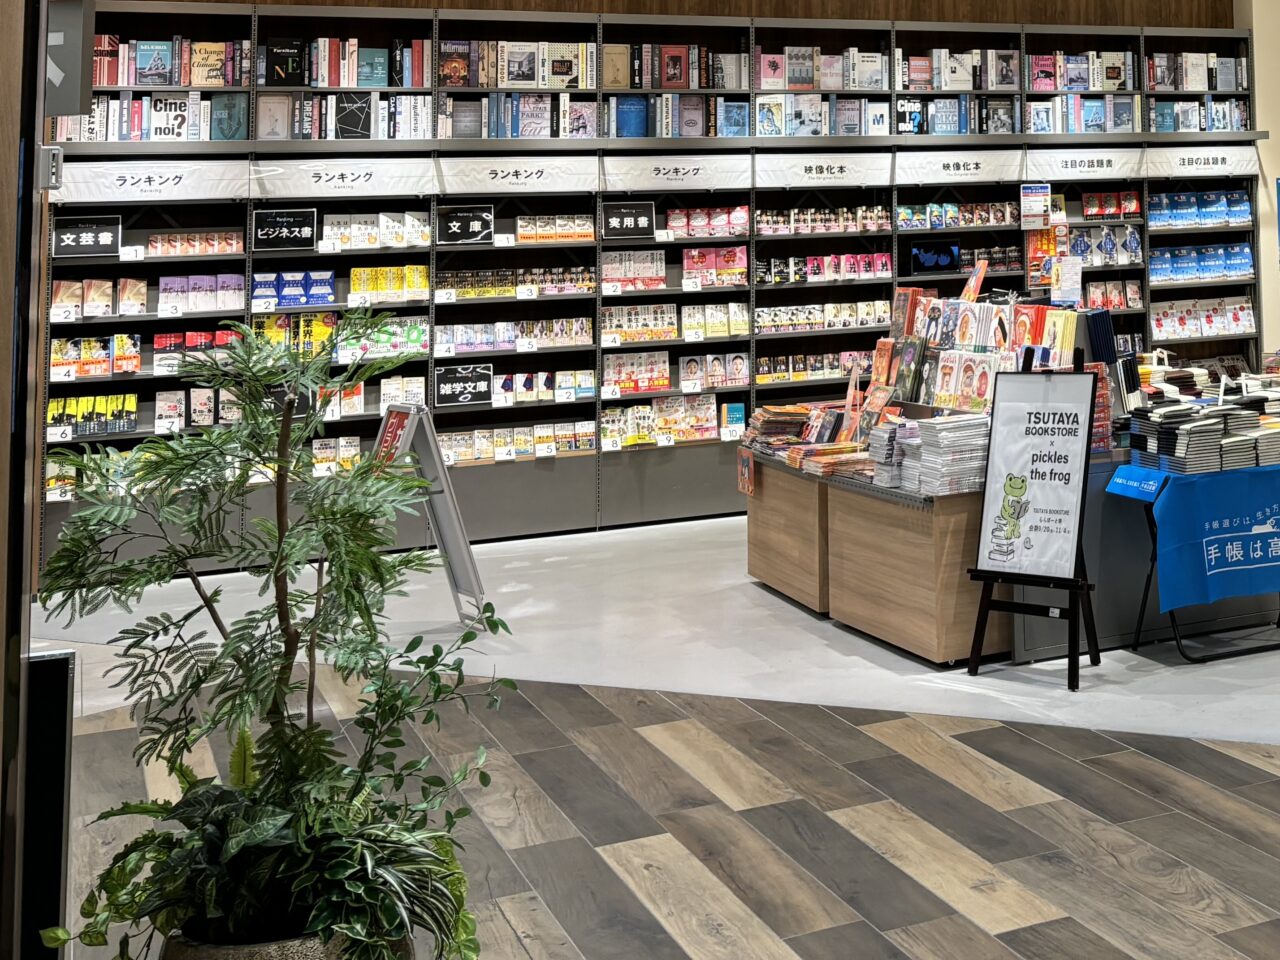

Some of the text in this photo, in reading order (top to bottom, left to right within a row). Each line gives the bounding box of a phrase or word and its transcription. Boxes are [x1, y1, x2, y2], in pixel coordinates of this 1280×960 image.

[199, 48, 225, 58] Change
[153, 98, 187, 112] Cine
[897, 100, 921, 112] Cine
[303, 100, 312, 134] DREAMS
[942, 161, 982, 172] 映像化本
[1060, 159, 1113, 169] 注目の話題書
[1178, 156, 1228, 166] 注目の話題書
[488, 168, 545, 181] ランキング
[652, 166, 701, 177] ランキング
[803, 164, 847, 175] 映像化本
[114, 173, 184, 187] ランキング
[311, 171, 374, 184] ランキング
[448, 220, 483, 233] 文庫
[608, 216, 650, 229] 実用書
[60, 232, 114, 246] 文芸書
[257, 227, 313, 239] ビジネス書
[439, 381, 489, 395] 雑学文庫
[1027, 412, 1079, 425] TSUTAYA
[1024, 426, 1079, 437] BOOKSTORE
[1031, 451, 1069, 465] pickles
[1030, 469, 1071, 485] the frog
